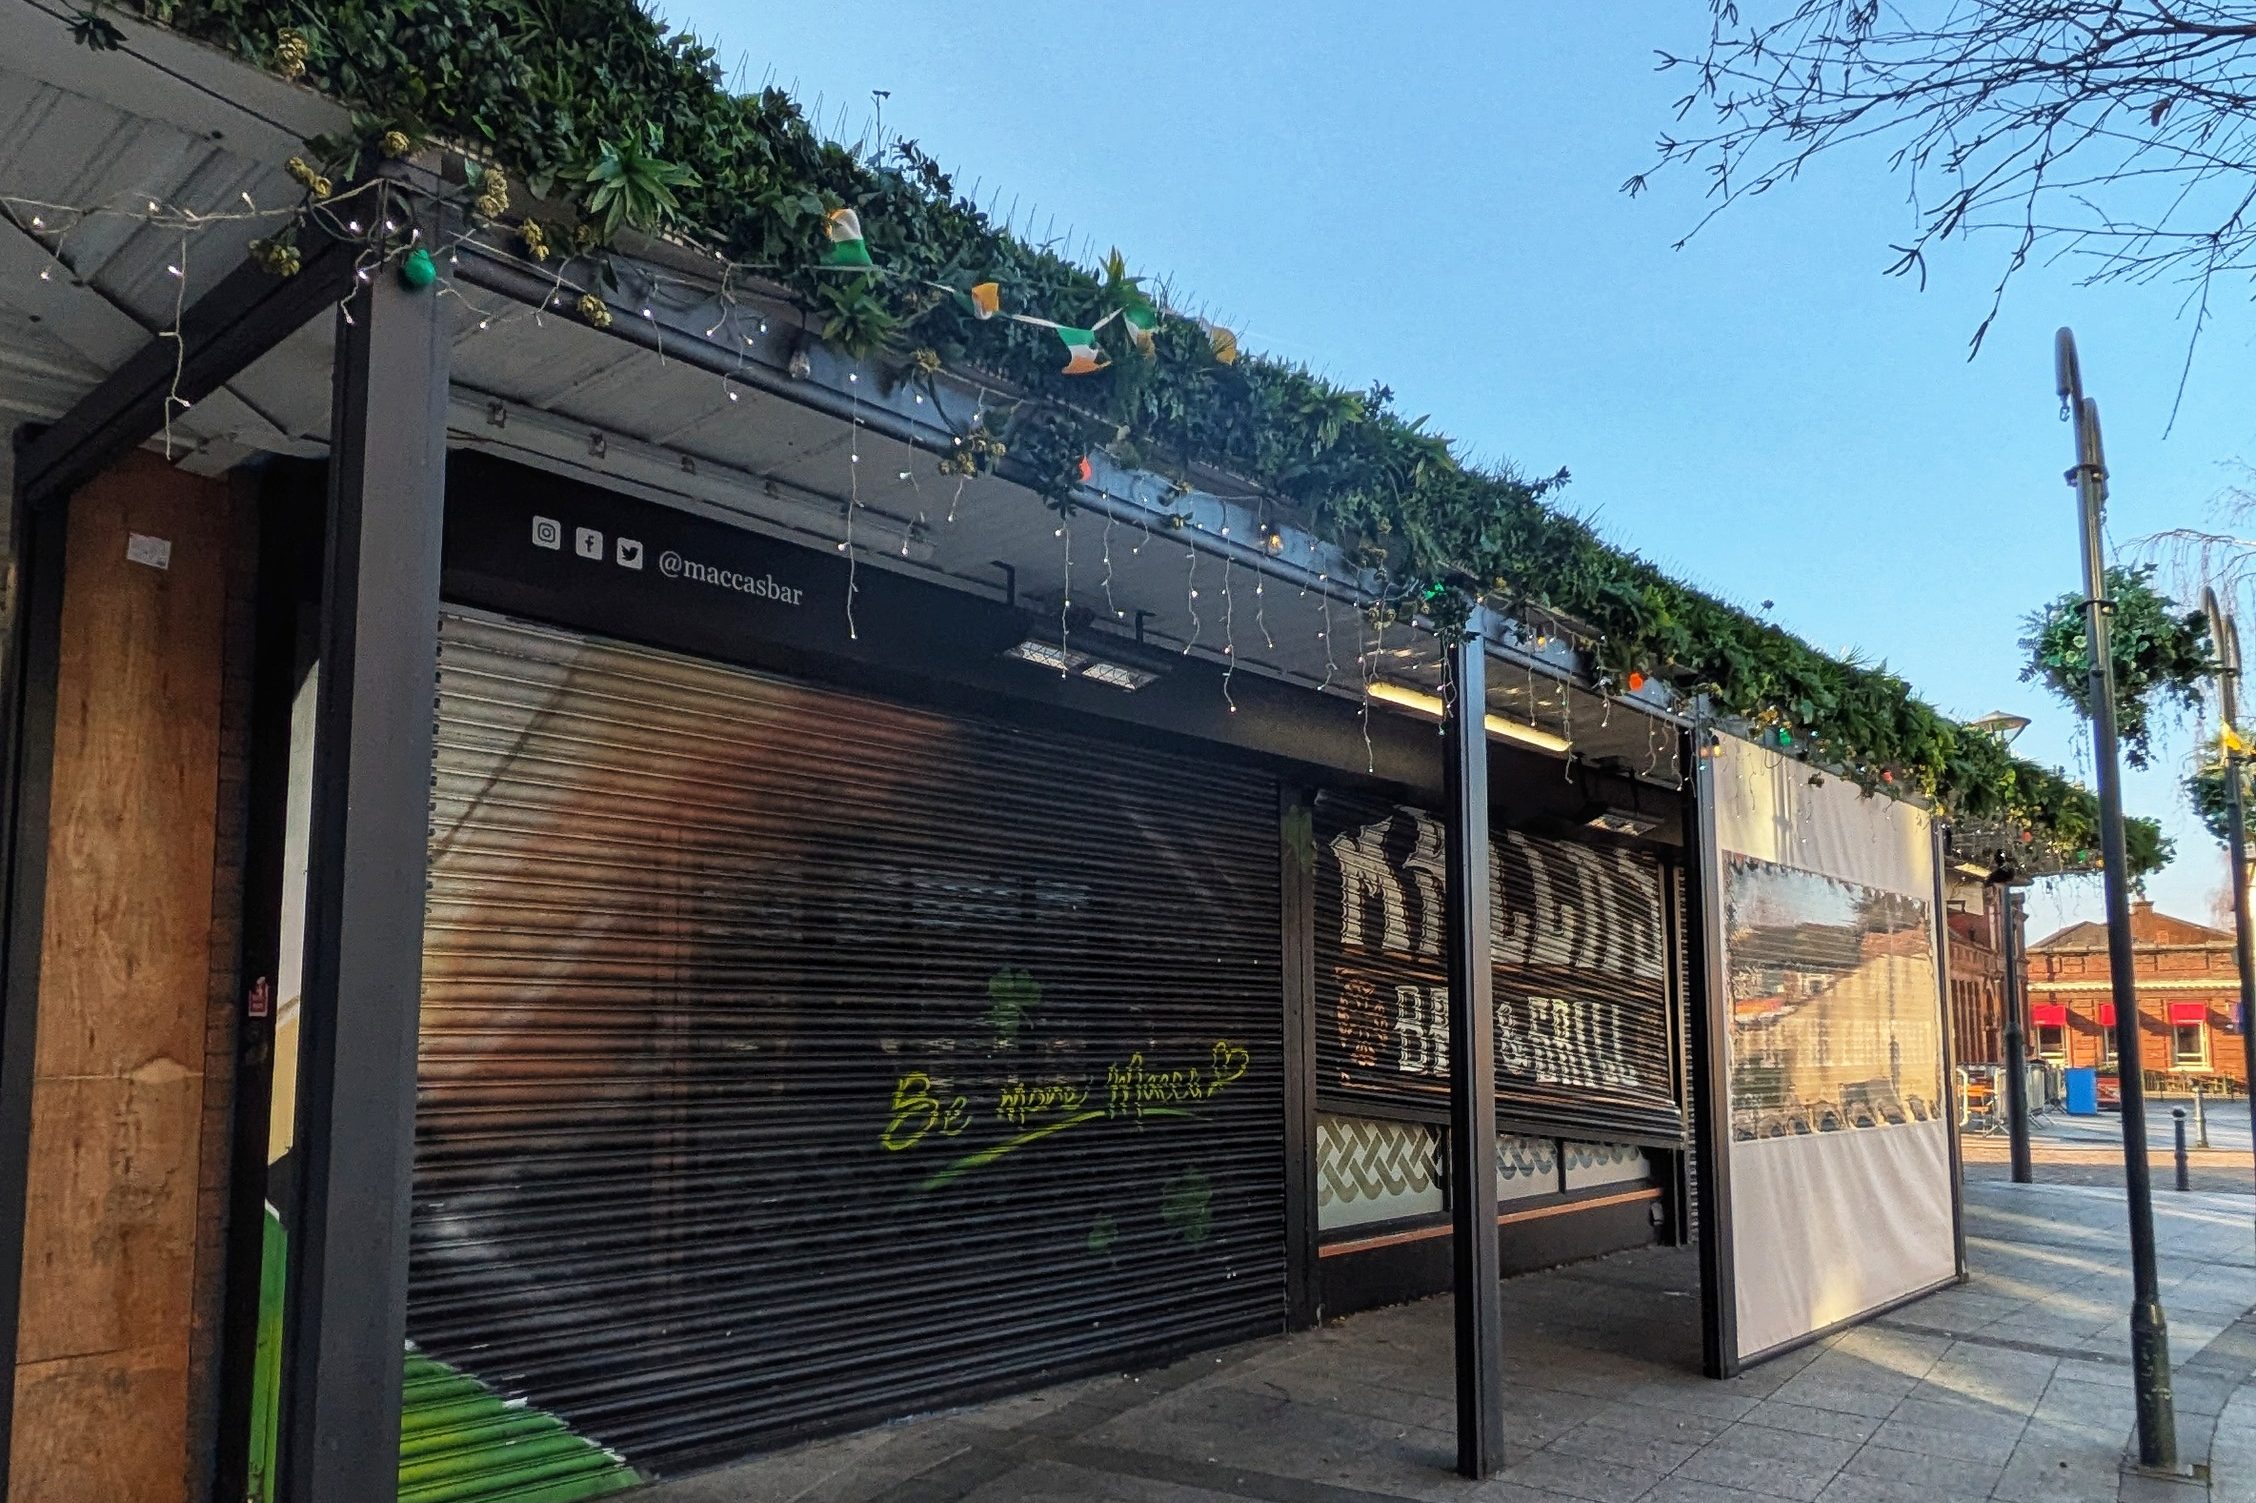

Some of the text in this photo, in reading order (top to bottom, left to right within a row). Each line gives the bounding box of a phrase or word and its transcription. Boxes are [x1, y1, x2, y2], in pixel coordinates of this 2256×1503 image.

[659, 550, 803, 606] @maccasbar
[1528, 996, 1640, 1088] GRILL
[878, 1070, 974, 1152] Be
